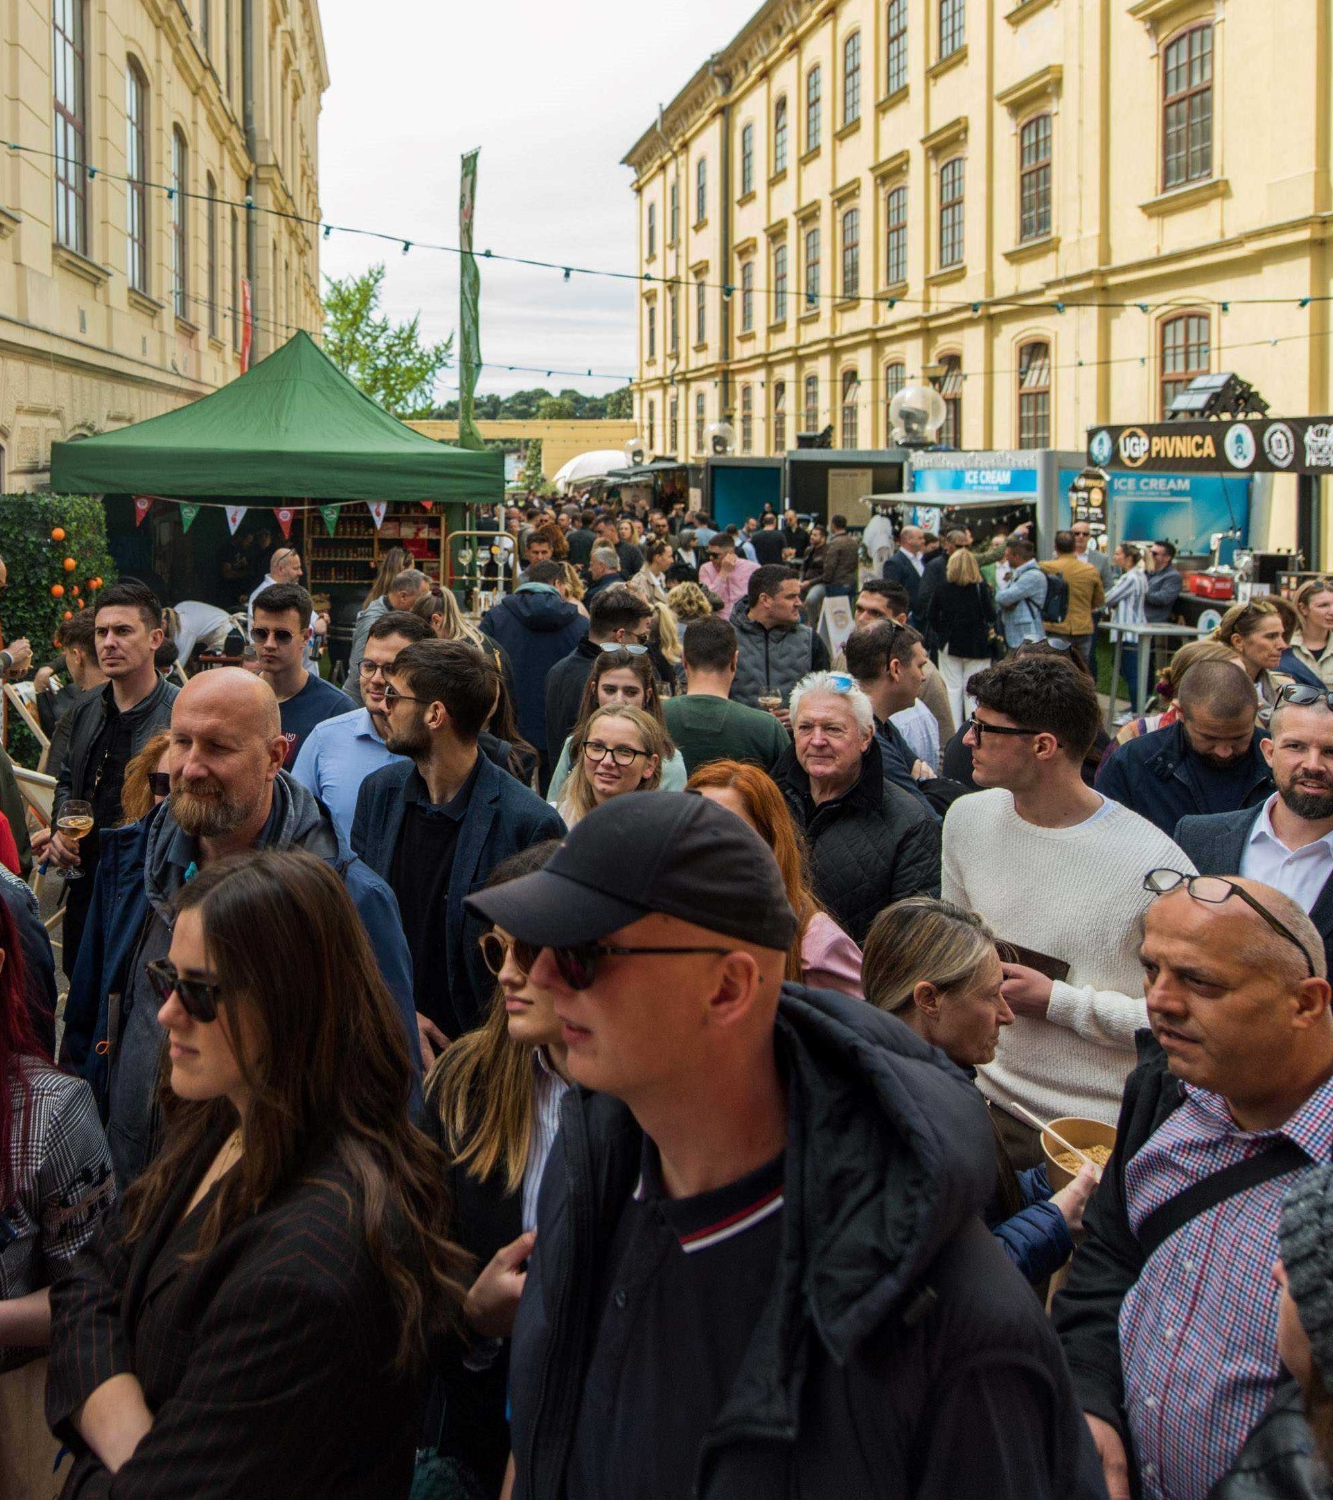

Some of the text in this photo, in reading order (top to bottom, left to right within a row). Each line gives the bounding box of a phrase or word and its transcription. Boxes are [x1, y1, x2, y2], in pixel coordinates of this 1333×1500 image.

[1119, 434, 1217, 459] UGP PIVNICA
[965, 470, 1011, 485] ICE CREAM
[1114, 477, 1137, 490] ICE
[1139, 477, 1191, 491] CREAM
